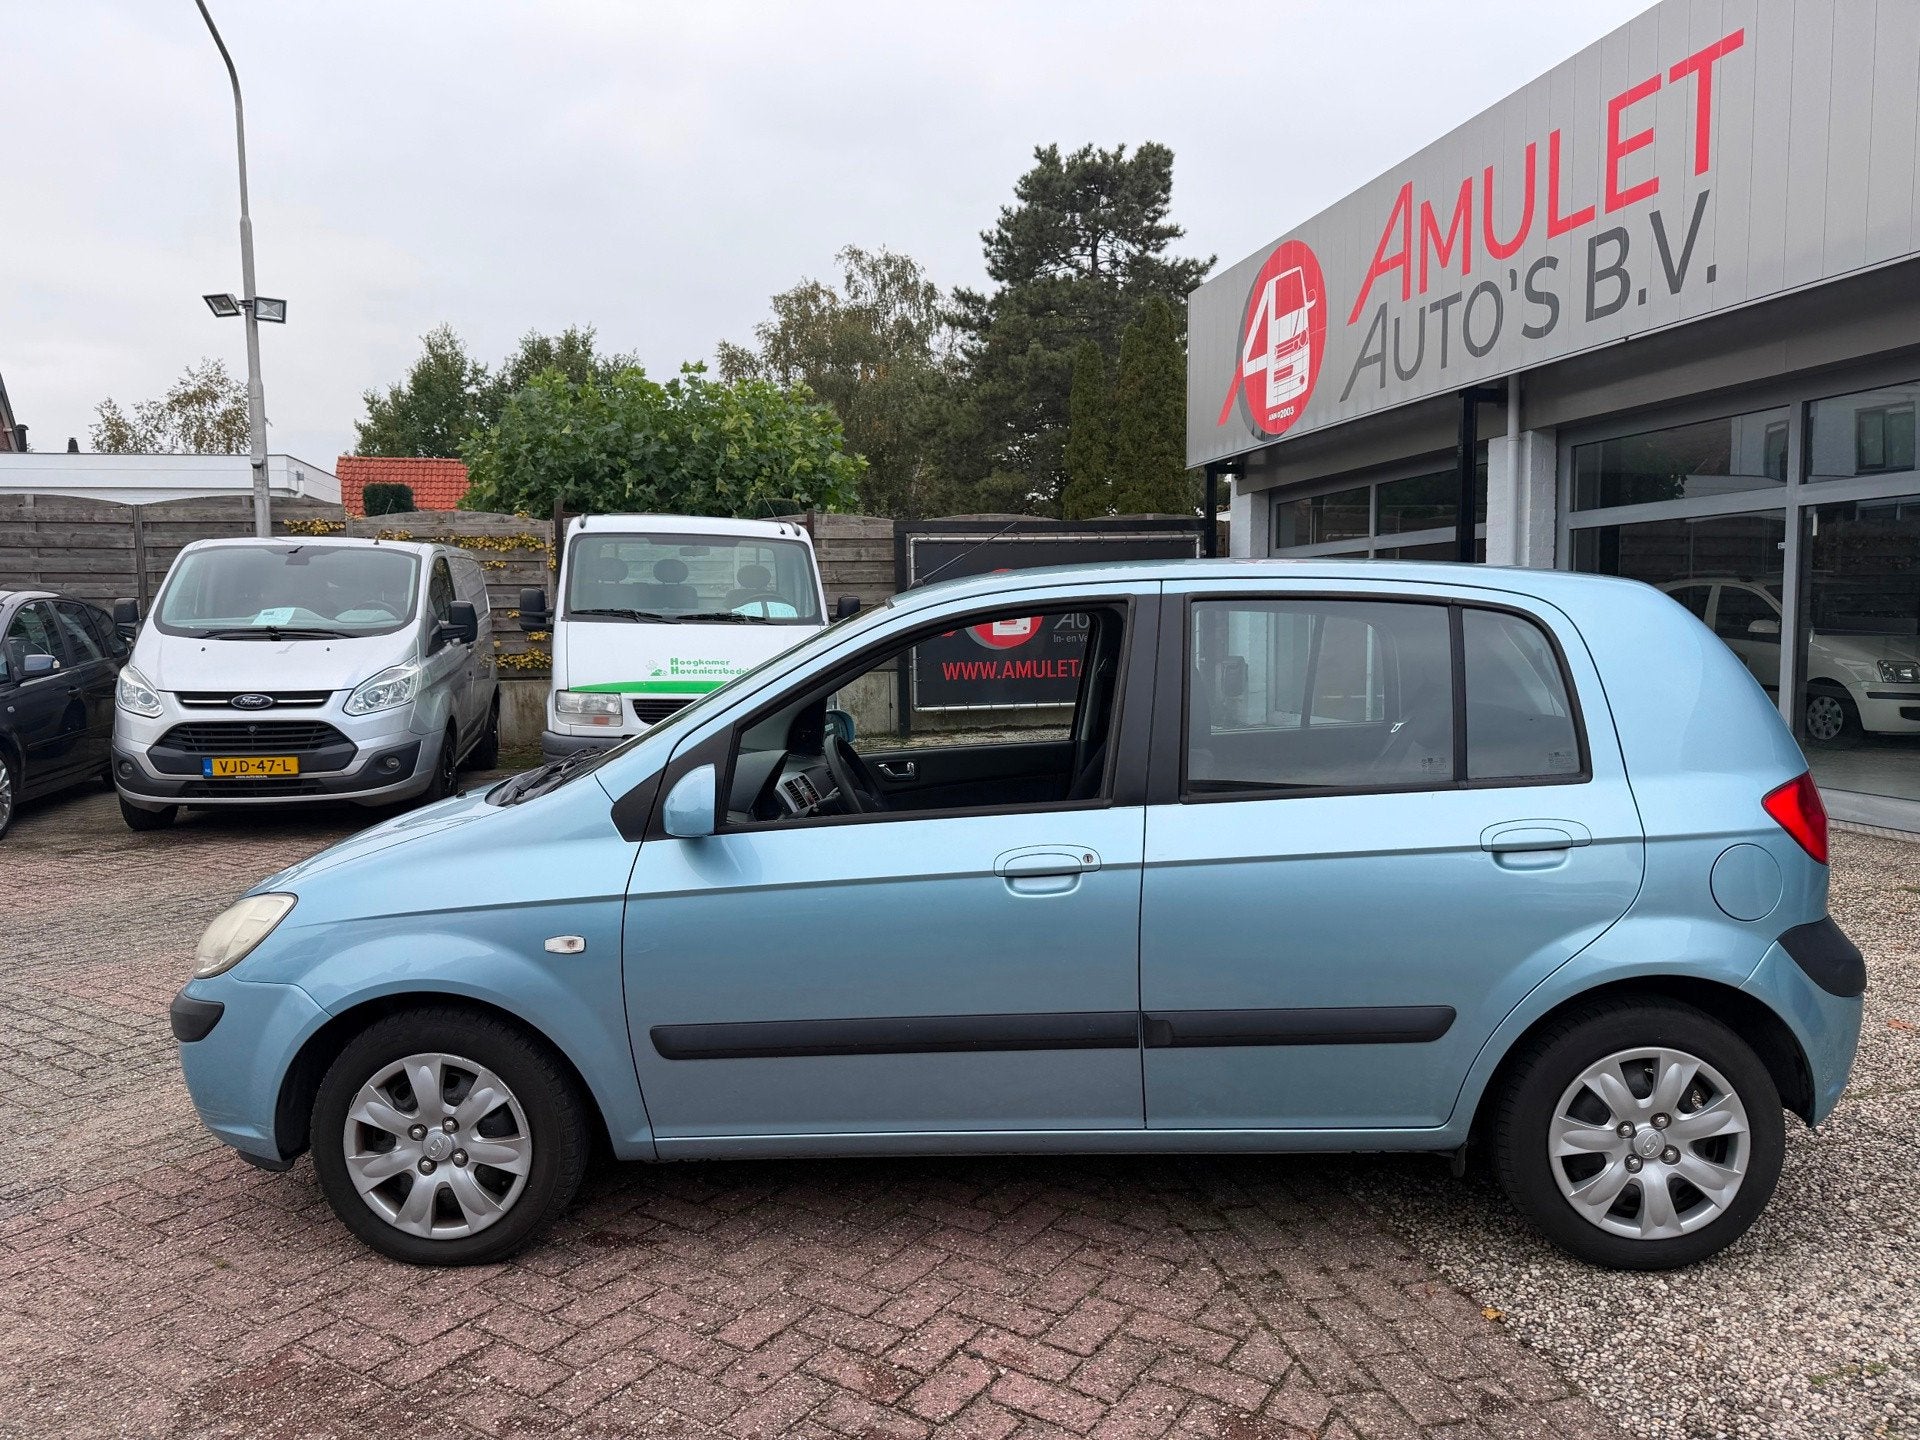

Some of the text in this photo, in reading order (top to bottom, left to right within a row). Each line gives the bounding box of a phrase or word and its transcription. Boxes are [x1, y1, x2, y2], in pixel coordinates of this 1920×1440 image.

[1347, 28, 1744, 325] AMULET
[1340, 189, 1716, 401] AUTO'S B.V.
[670, 658, 730, 666] Hoogkamer
[670, 666, 750, 674] Hoveniersbedr
[942, 659, 1082, 680] WWW.AMULET
[240, 696, 263, 705] Ford
[219, 760, 291, 773] VJD-47-L
